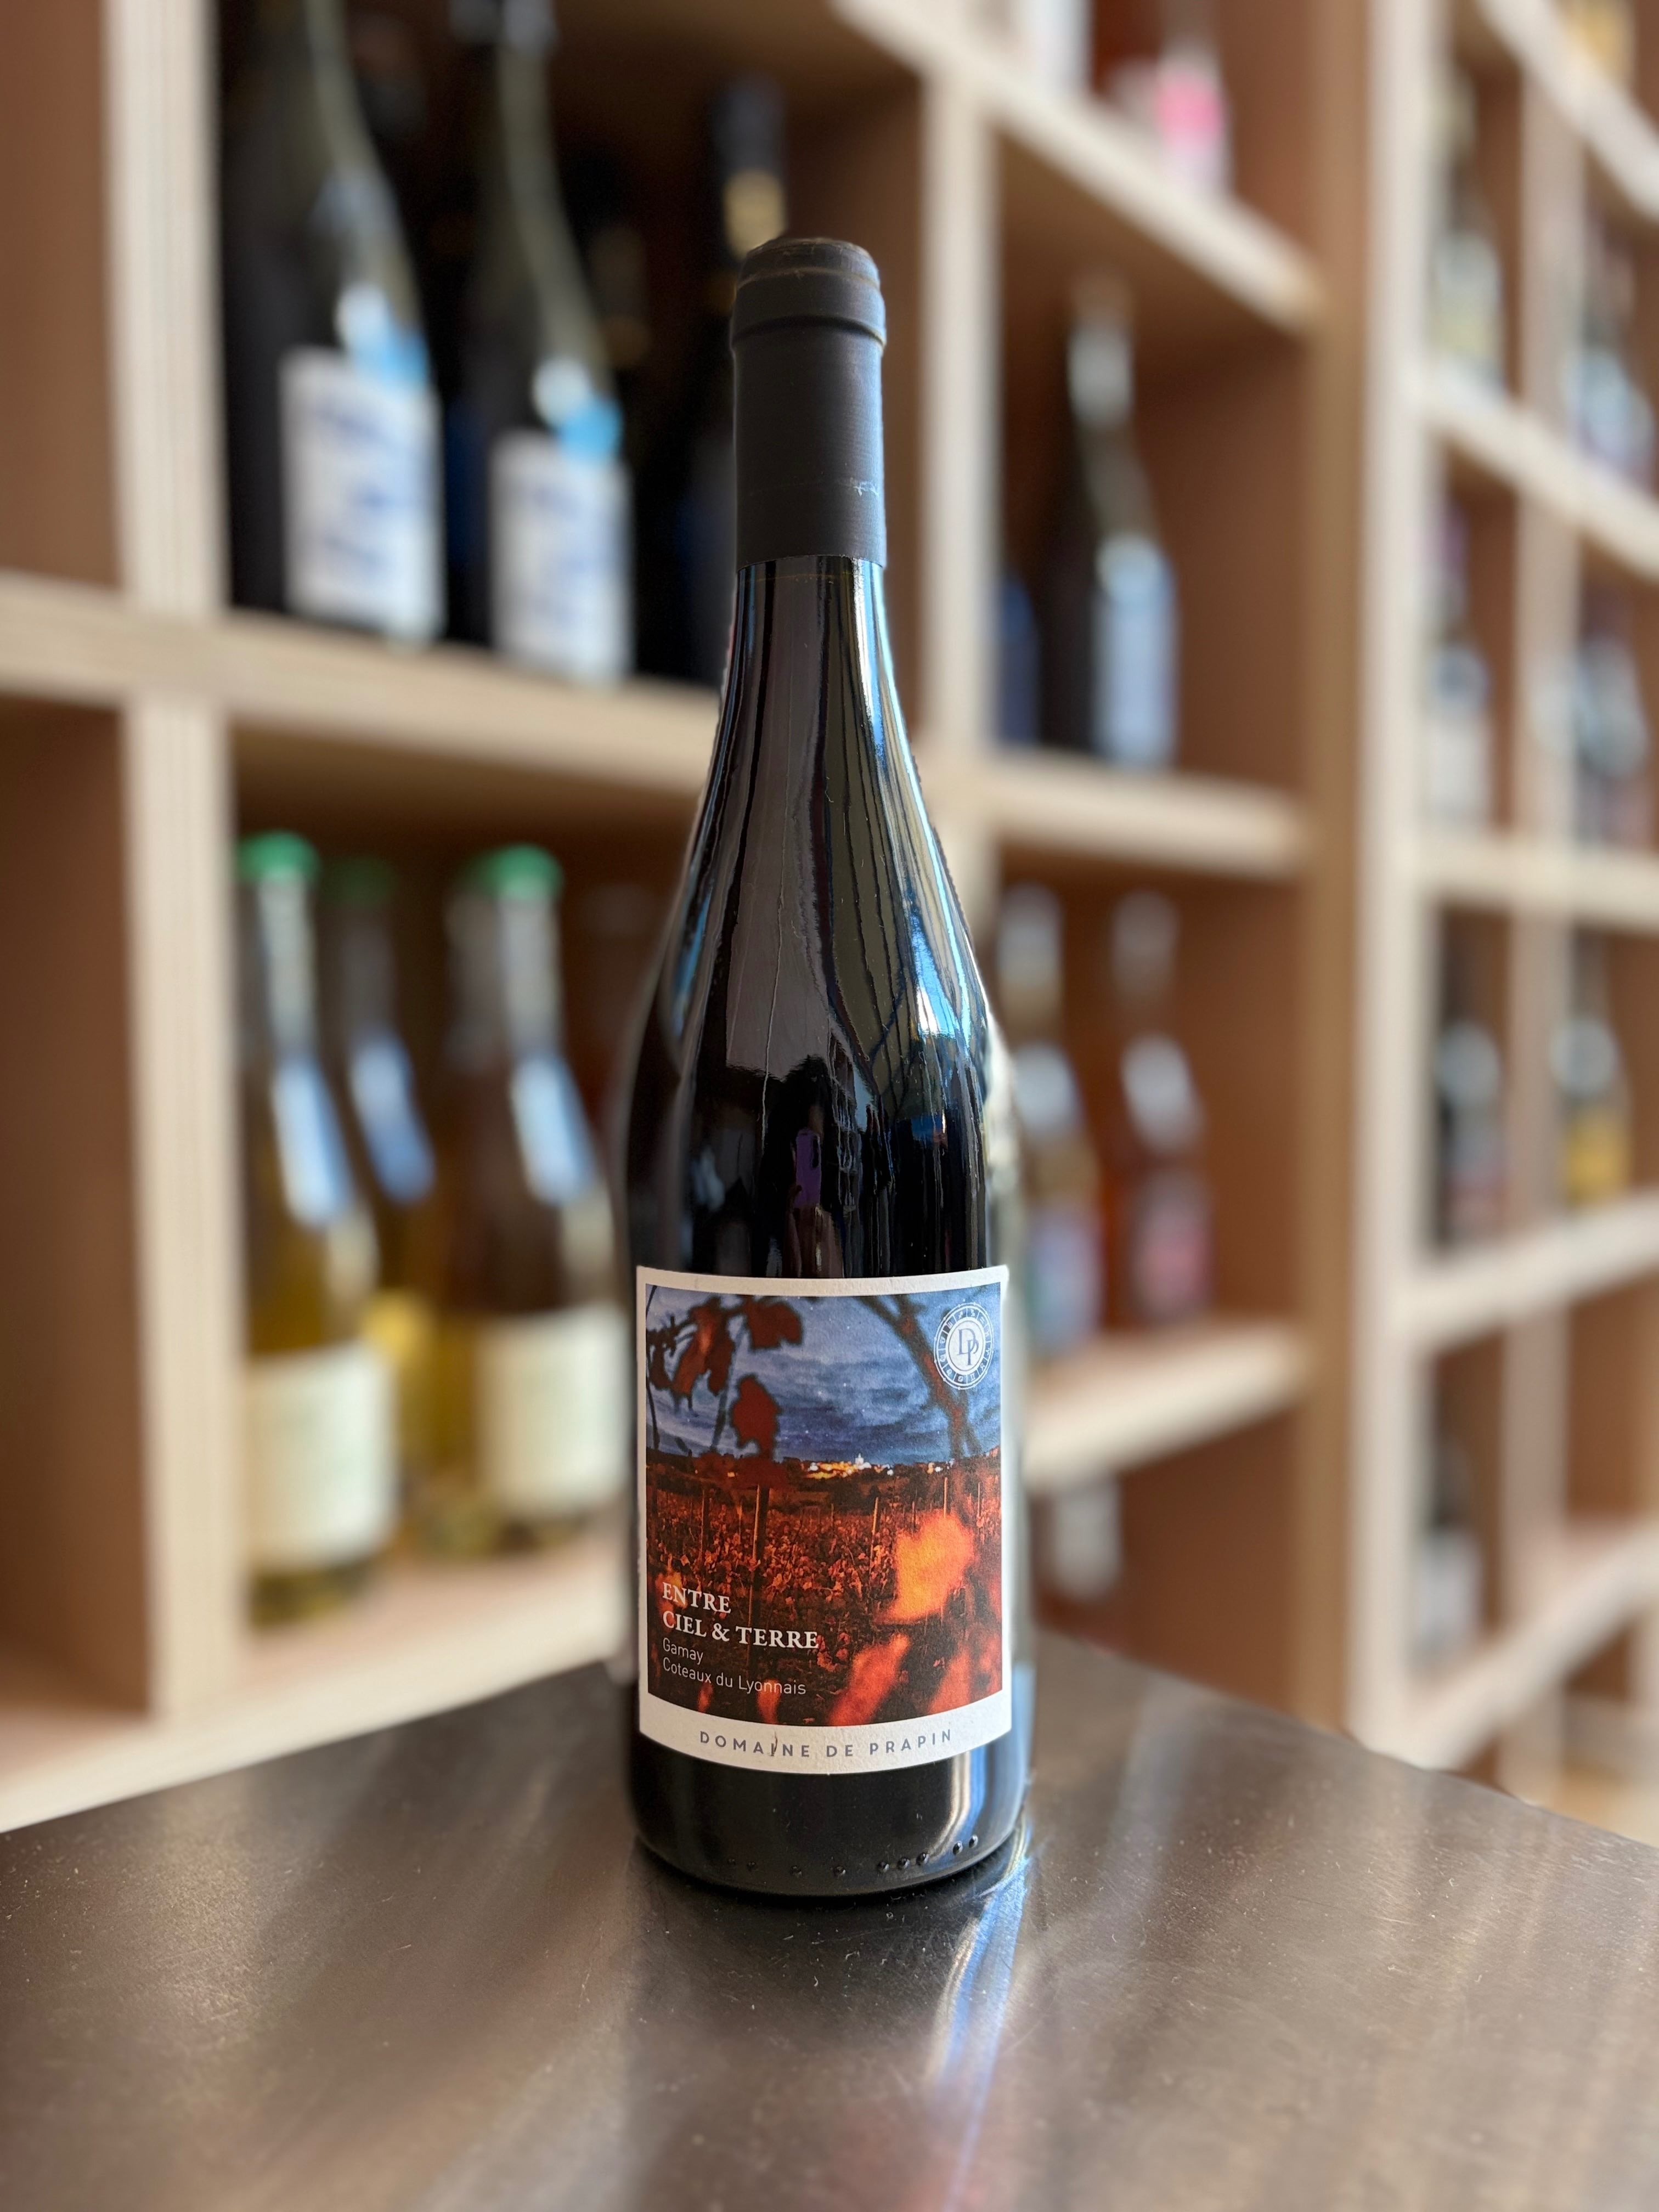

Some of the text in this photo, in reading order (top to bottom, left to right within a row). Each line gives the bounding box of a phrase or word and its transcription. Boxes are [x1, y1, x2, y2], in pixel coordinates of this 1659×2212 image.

[662, 1582, 731, 1614] ENTRE
[663, 1610, 819, 1649] CIEL & TERRE
[663, 1637, 704, 1665] Gamay
[663, 1657, 806, 1695] Coteaux du Lyonnais
[700, 1729, 951, 1758] DOMAINE DE PRAPIN
